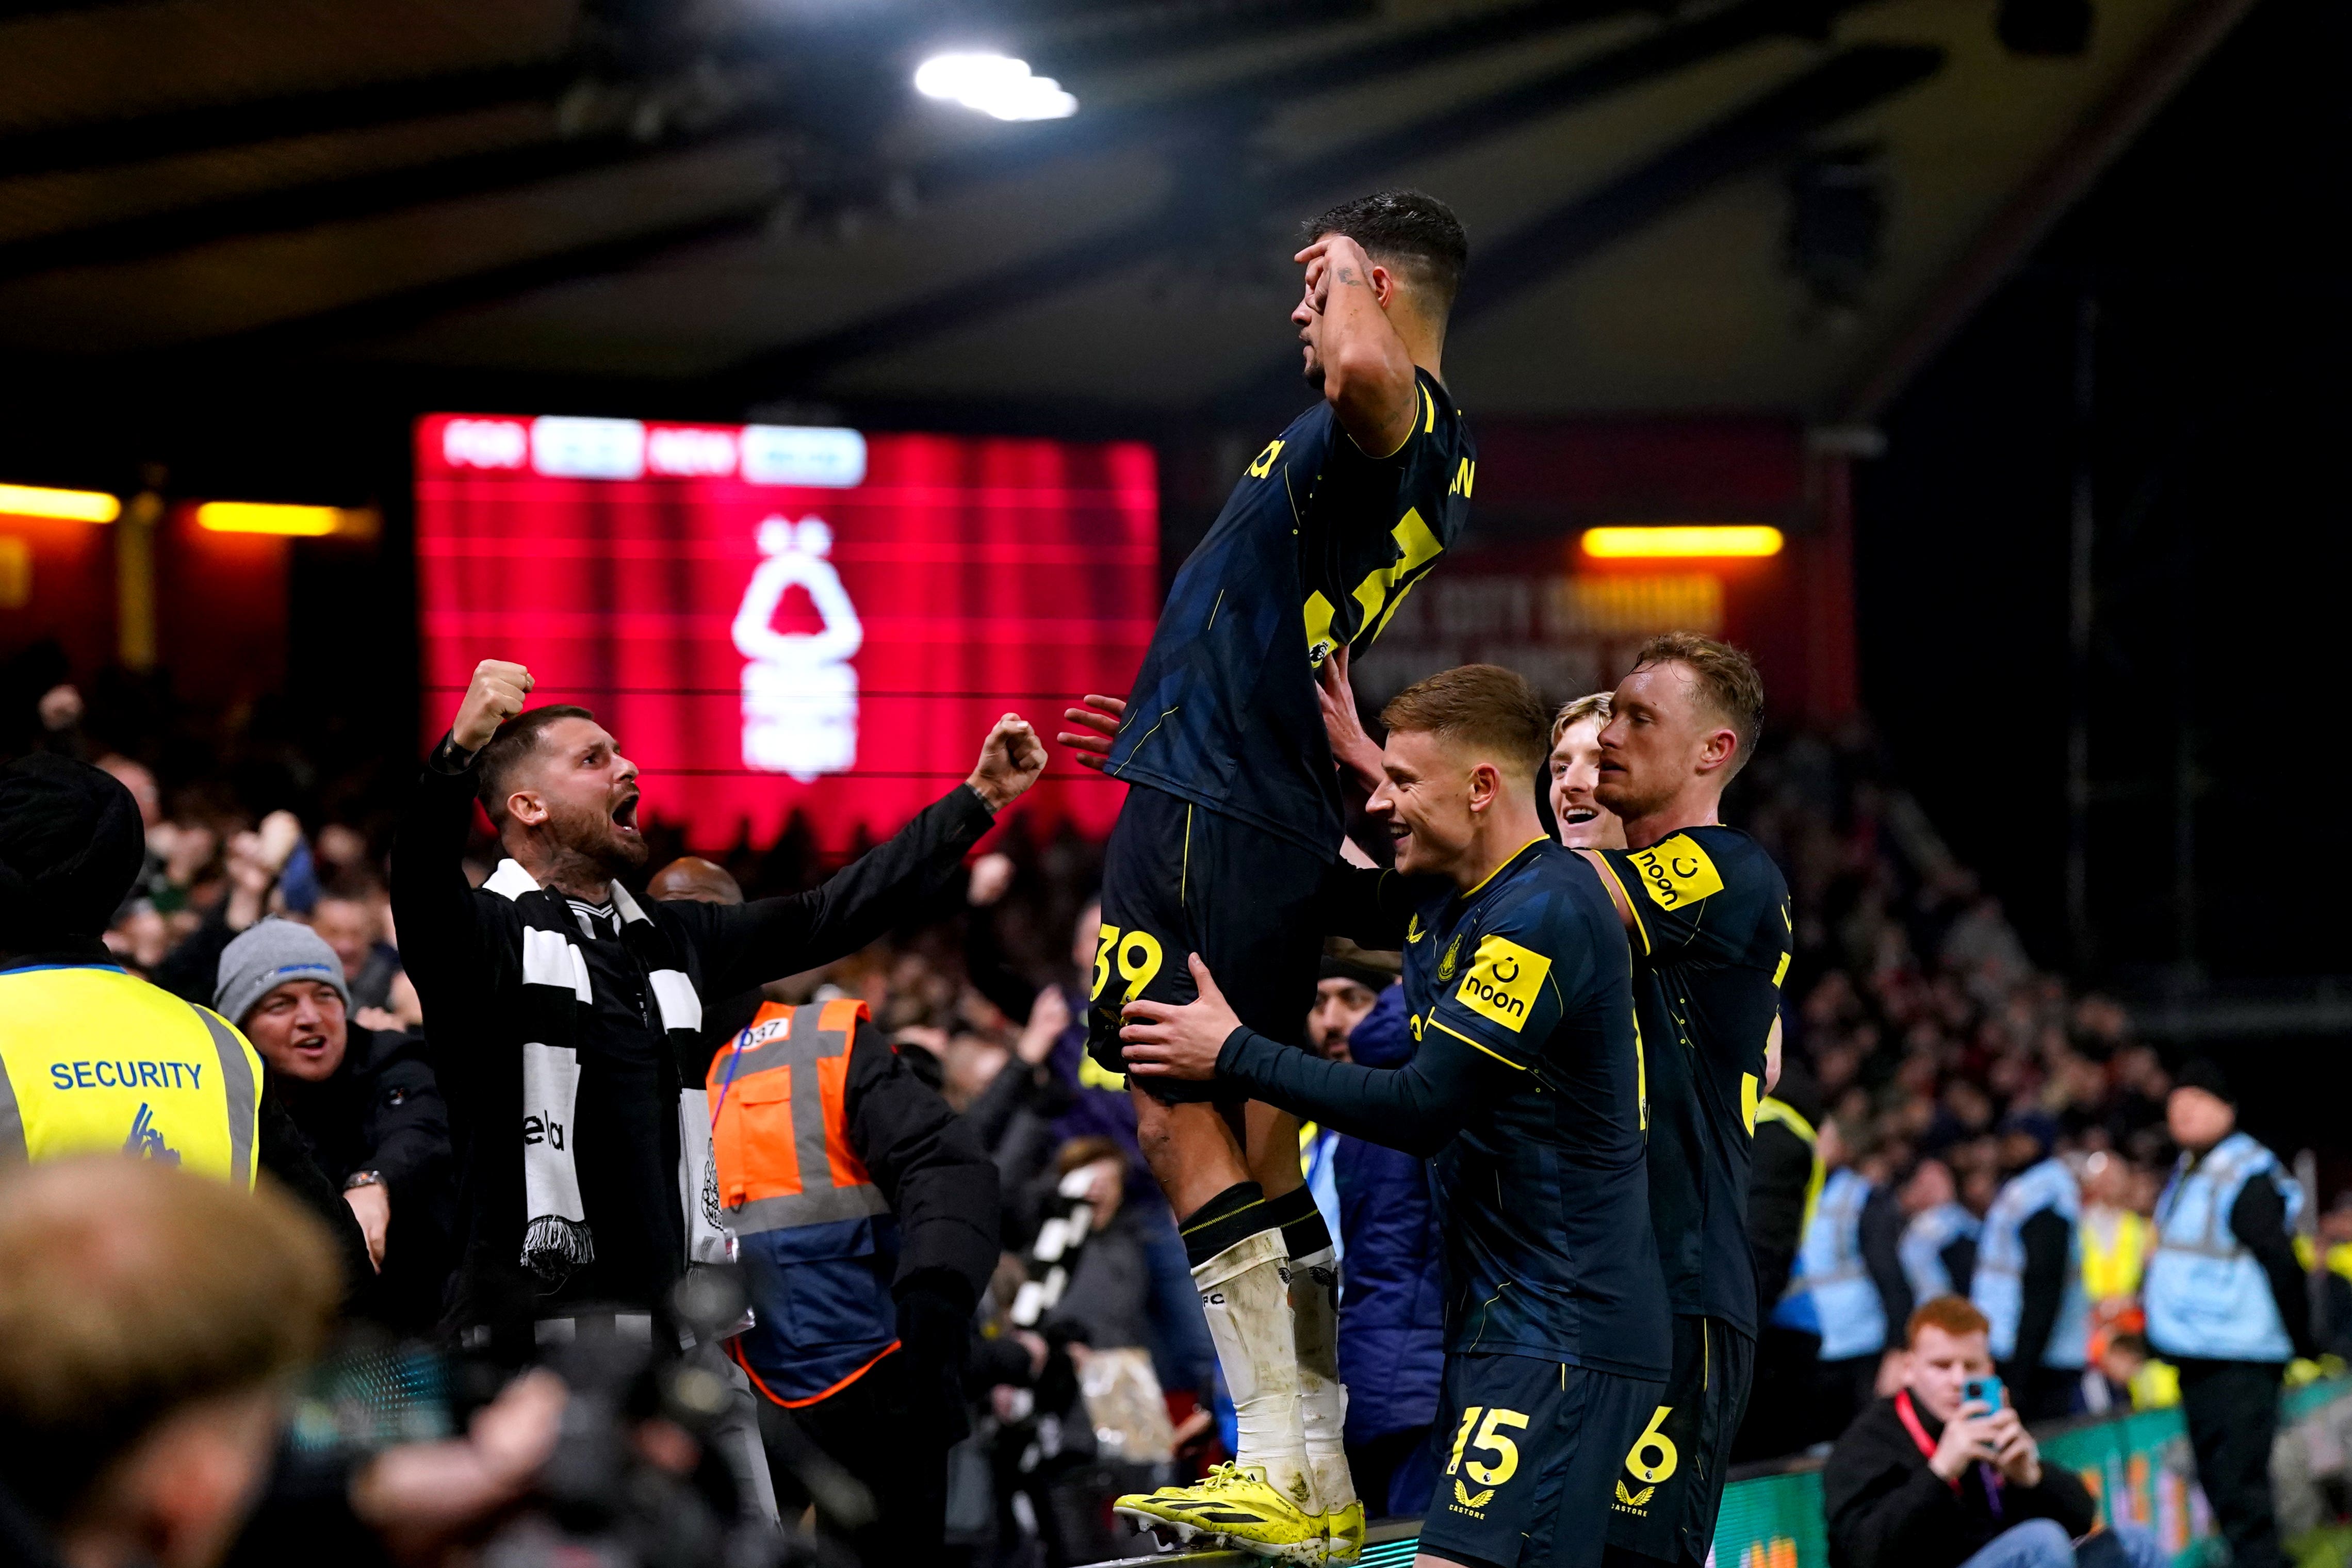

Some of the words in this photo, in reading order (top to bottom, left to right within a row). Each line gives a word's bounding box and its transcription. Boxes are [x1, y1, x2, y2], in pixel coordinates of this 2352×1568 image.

[1639, 852, 1678, 906] noon
[1089, 923, 1163, 1005] 39
[1466, 976, 1524, 1017] noon
[51, 1061, 202, 1089] SECURITY
[1446, 1407, 1529, 1485] 15
[1625, 1406, 1677, 1483] 6
[1449, 1505, 1485, 1520] CASTORE
